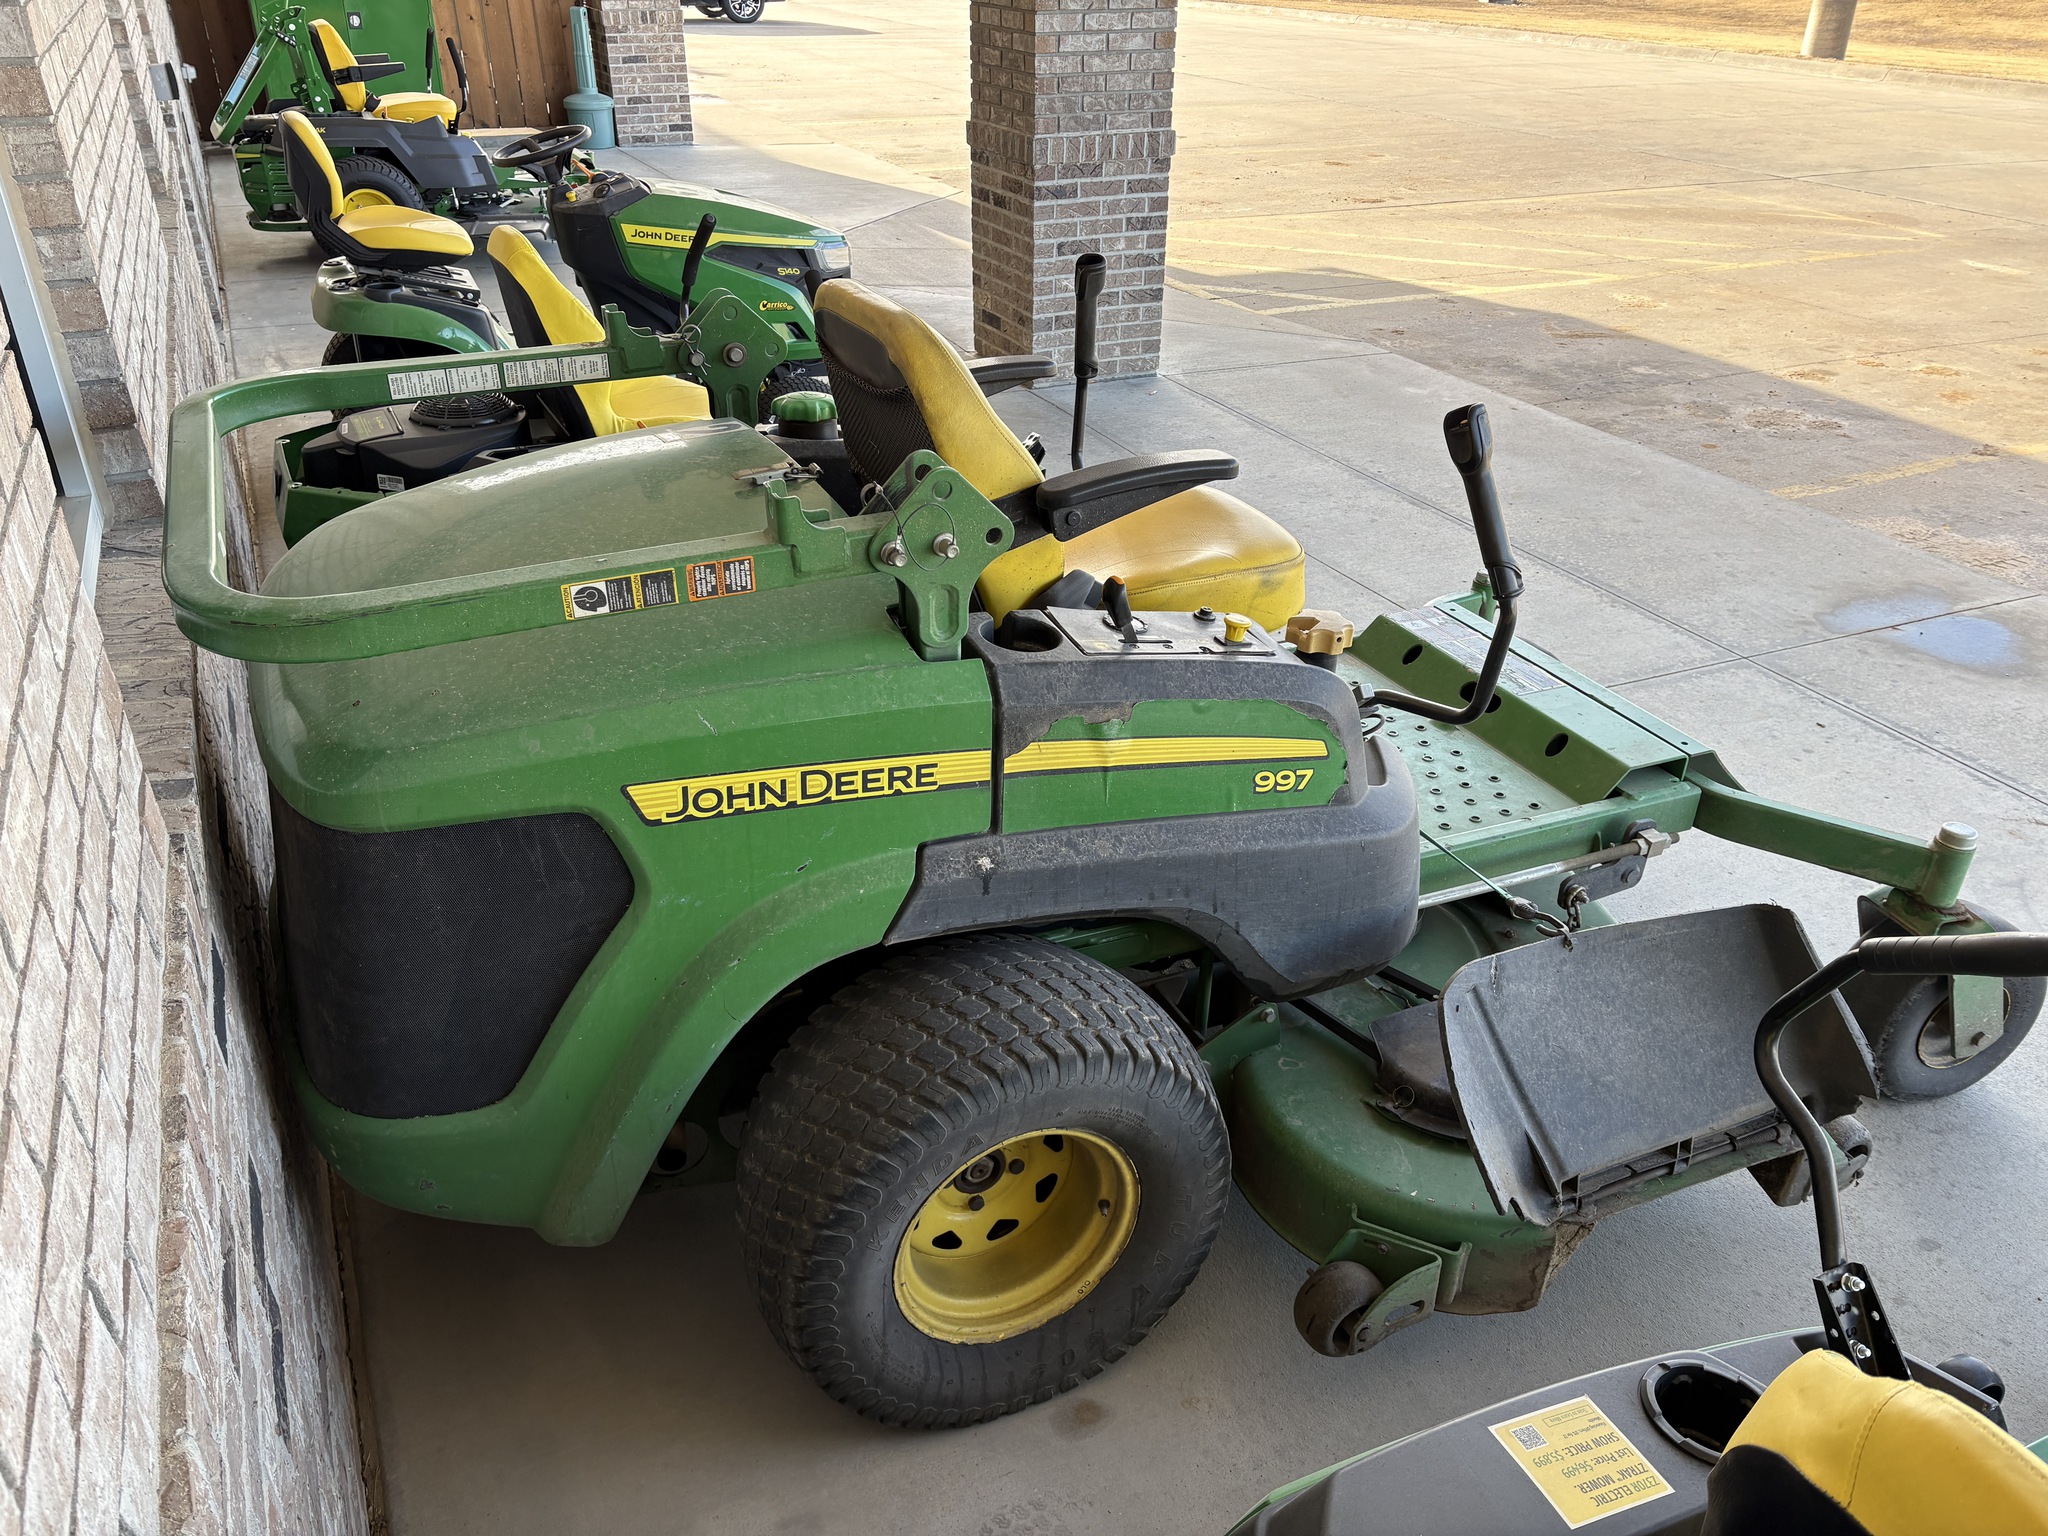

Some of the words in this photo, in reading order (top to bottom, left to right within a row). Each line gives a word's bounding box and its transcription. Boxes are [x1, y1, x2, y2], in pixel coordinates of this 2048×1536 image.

[631, 229, 662, 240] JOHN
[777, 267, 800, 276] S140
[759, 300, 788, 311] Carrico
[633, 575, 643, 604] ATENCIÓN
[563, 587, 572, 614] CAUTION
[1253, 768, 1314, 793] 997
[665, 778, 787, 819] JOHN
[800, 763, 939, 800] DEERE
[866, 1132, 985, 1251] KENDA
[1561, 1441, 1593, 1457] PRICE:
[1591, 1432, 1620, 1448] SHOW
[1533, 1449, 1565, 1468] $5,899
[1590, 1452, 1618, 1466] Price:
[1614, 1447, 1634, 1459] List
[1561, 1459, 1594, 1478] $6,499
[1574, 1474, 1616, 1494] MOWER.
[1630, 1475, 1660, 1492] Z370R
[1590, 1485, 1633, 1507] ELECTRIC
